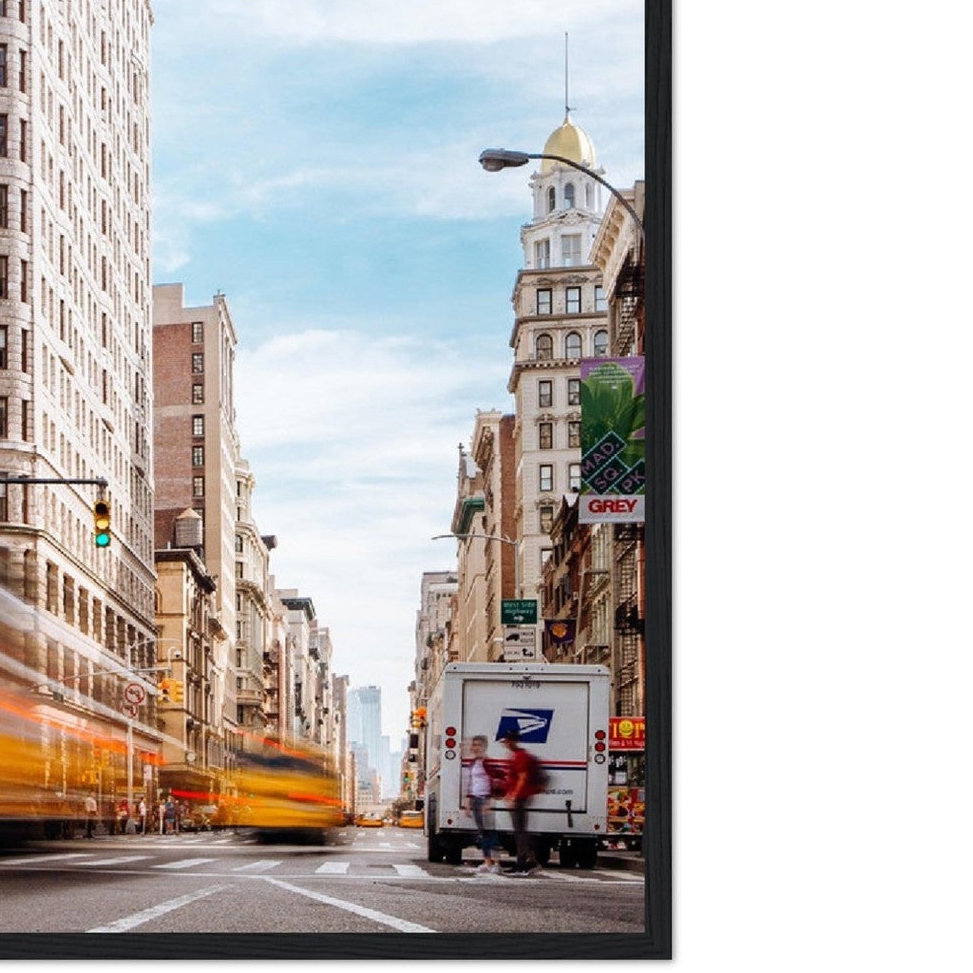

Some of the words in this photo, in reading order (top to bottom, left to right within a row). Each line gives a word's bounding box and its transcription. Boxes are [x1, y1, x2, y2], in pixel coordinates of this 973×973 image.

[581, 441, 620, 476] MAD.
[594, 466, 623, 490] SQ.
[588, 499, 638, 513] GREY
